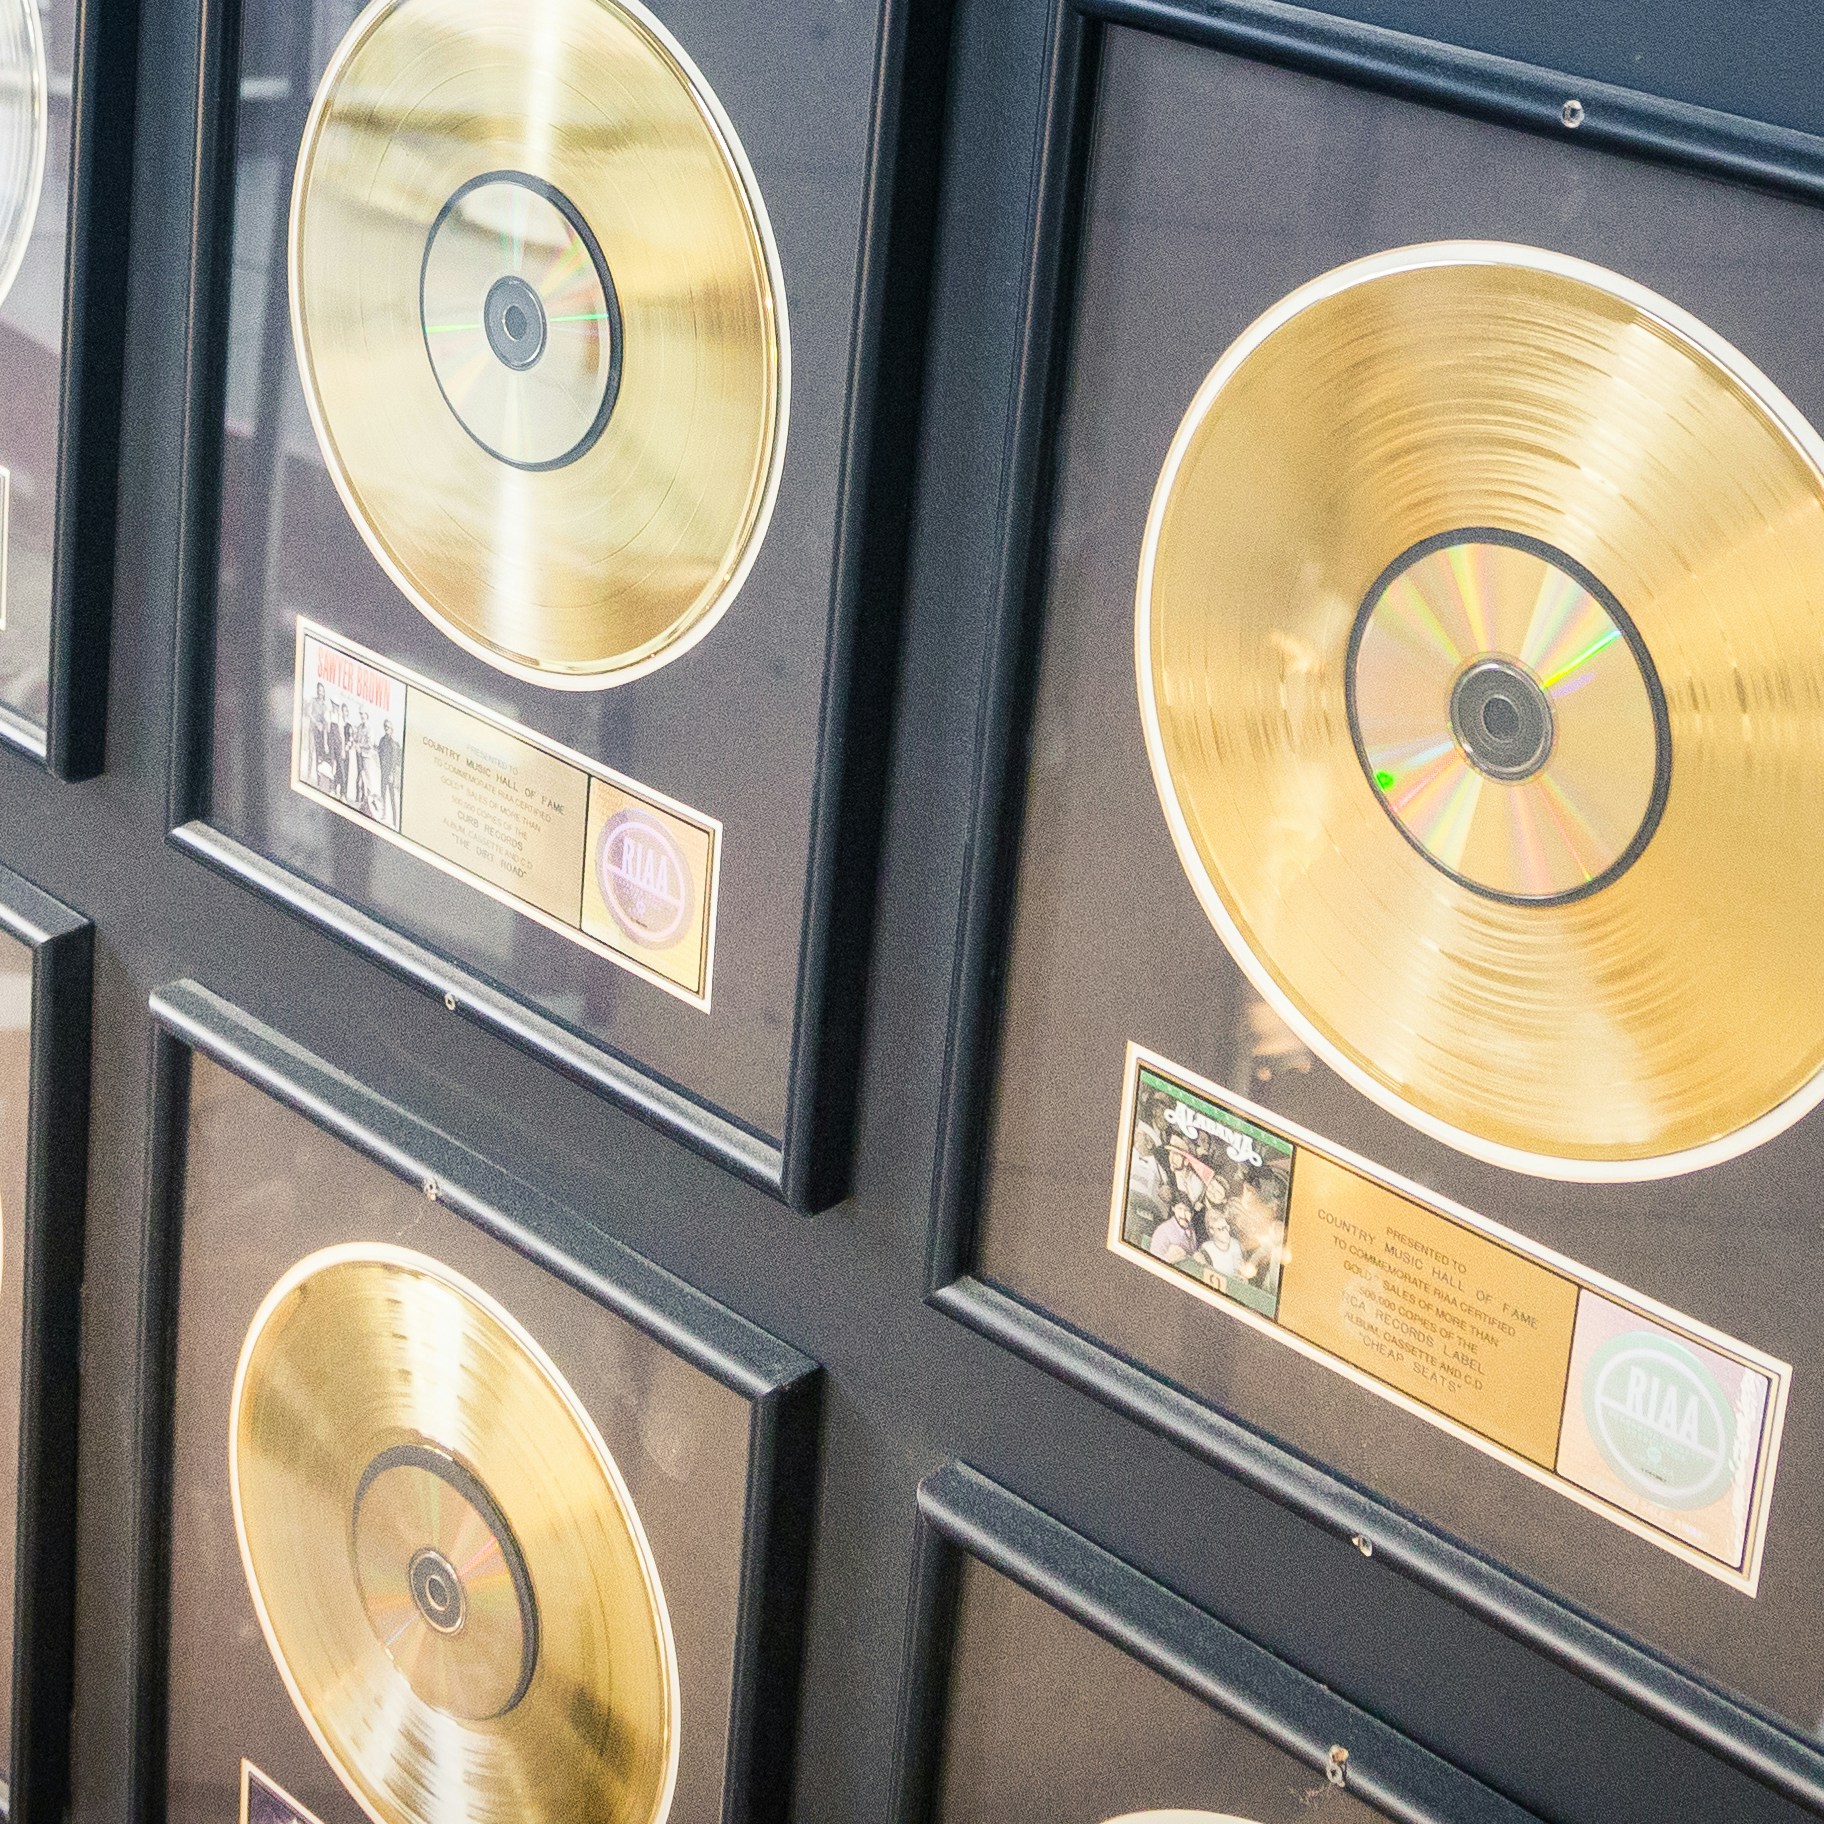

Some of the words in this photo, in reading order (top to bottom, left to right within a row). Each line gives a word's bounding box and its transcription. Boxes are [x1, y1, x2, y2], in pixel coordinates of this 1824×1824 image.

[316, 643, 353, 694] SAWYER
[356, 662, 391, 712] BROWN
[422, 735, 460, 763] COUNTRY
[465, 757, 491, 778] MUSIC
[495, 772, 518, 792] HALL
[524, 786, 535, 801] OF
[541, 794, 565, 816] FAME
[457, 809, 479, 829] CURB
[483, 823, 523, 852] RECORDS
[475, 845, 494, 864] DIRT
[621, 834, 669, 894] RIAA
[1163, 1099, 1264, 1168] ALABAMA
[1317, 1207, 1376, 1248] COUNTRY
[1383, 1241, 1423, 1272] MUSIC
[1431, 1265, 1466, 1294] HALL
[1475, 1287, 1493, 1307] OF
[1502, 1301, 1539, 1331] FAME
[1385, 1225, 1449, 1267] PRESENTED
[1450, 1258, 1467, 1276] TO
[1331, 1235, 1347, 1252] TO
[1348, 1244, 1431, 1294] COMMEMORATE
[1433, 1287, 1458, 1308] RIAA
[1459, 1300, 1516, 1338] CERTIFIED
[1382, 1279, 1416, 1306] SALES
[1417, 1298, 1434, 1315] OF
[1434, 1306, 1467, 1332] MORE
[1469, 1324, 1499, 1348] THAN
[1374, 1308, 1434, 1349] RECORDS
[1442, 1343, 1486, 1376] LABEL
[1382, 1330, 1438, 1369] CASSETTE
[1439, 1360, 1462, 1381] AND
[1397, 1305, 1438, 1334] COPIES
[1439, 1326, 1456, 1344] OF
[1456, 1335, 1478, 1355] THE
[1624, 1363, 1704, 1445] RIAA
